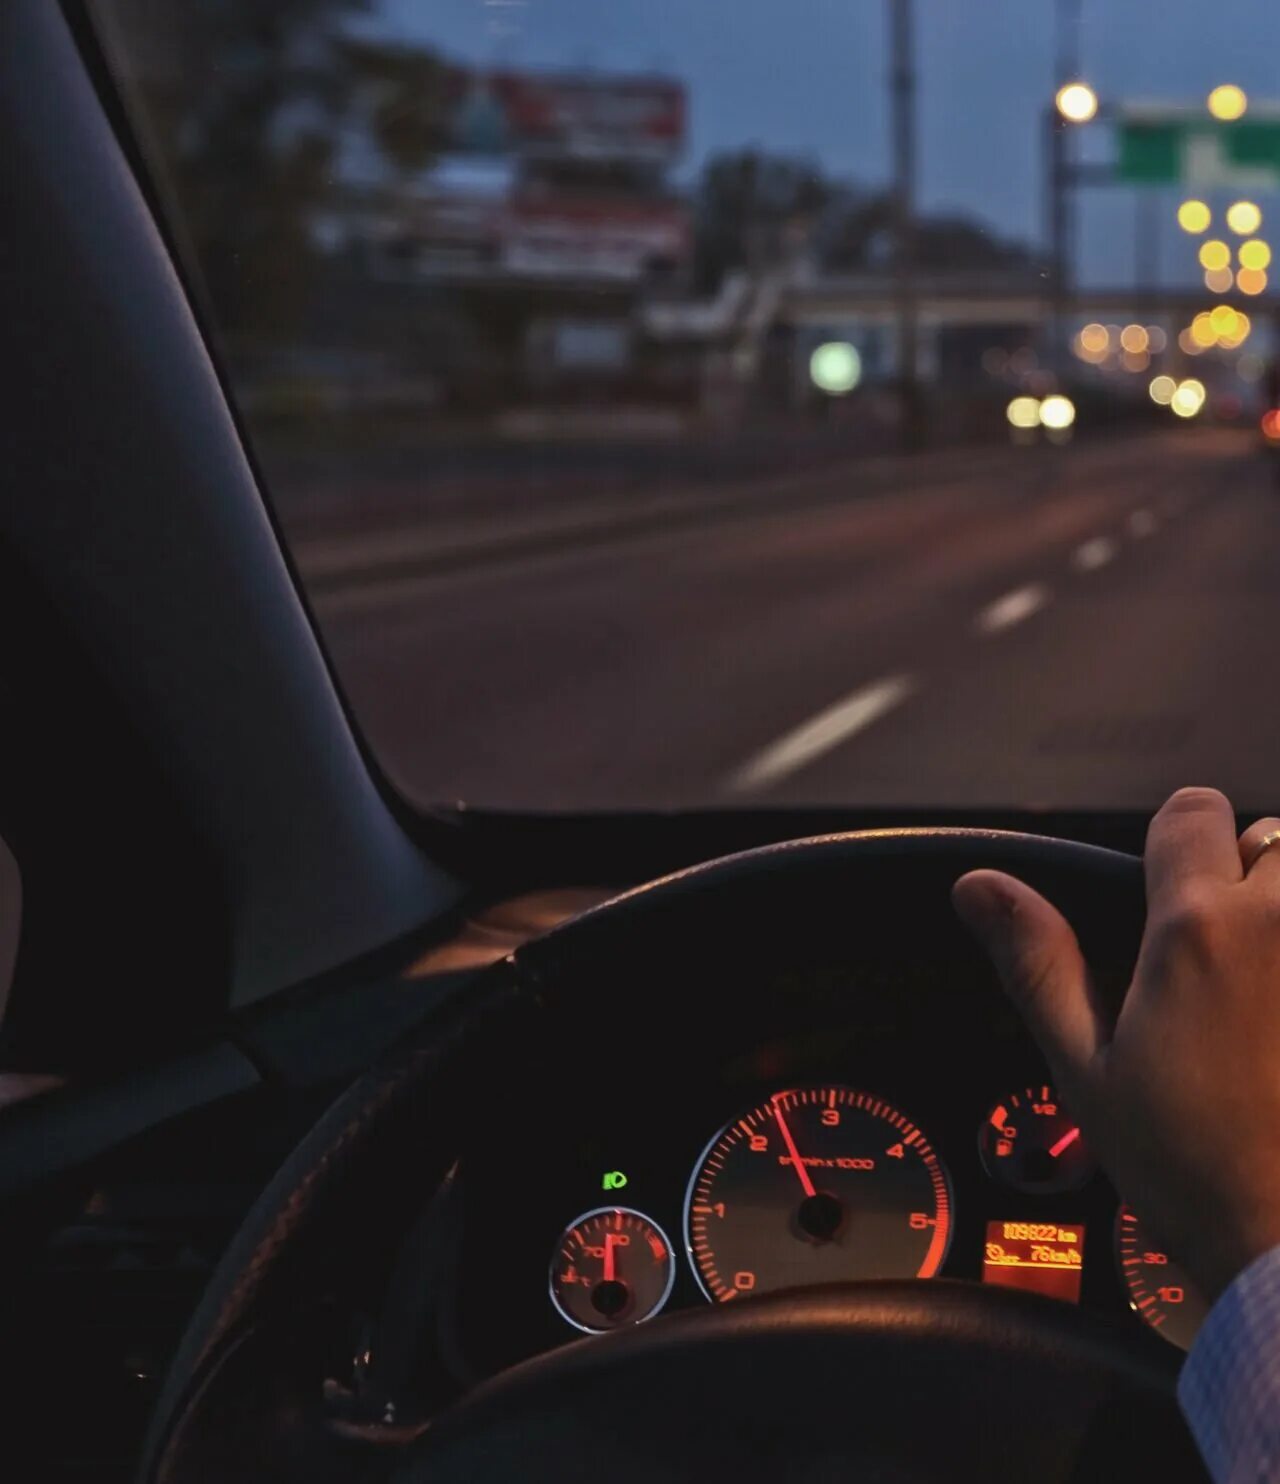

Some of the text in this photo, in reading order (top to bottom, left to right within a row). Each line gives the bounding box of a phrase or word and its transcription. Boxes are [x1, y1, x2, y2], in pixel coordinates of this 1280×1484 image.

[822, 1109, 840, 1126] 3
[750, 1135, 768, 1152] 2
[885, 1143, 904, 1159] 4
[836, 1157, 875, 1170] 1000
[714, 1202, 725, 1218] 1
[910, 1212, 929, 1230] 5
[735, 1271, 755, 1290] 0
[1157, 1287, 1184, 1303] 10
